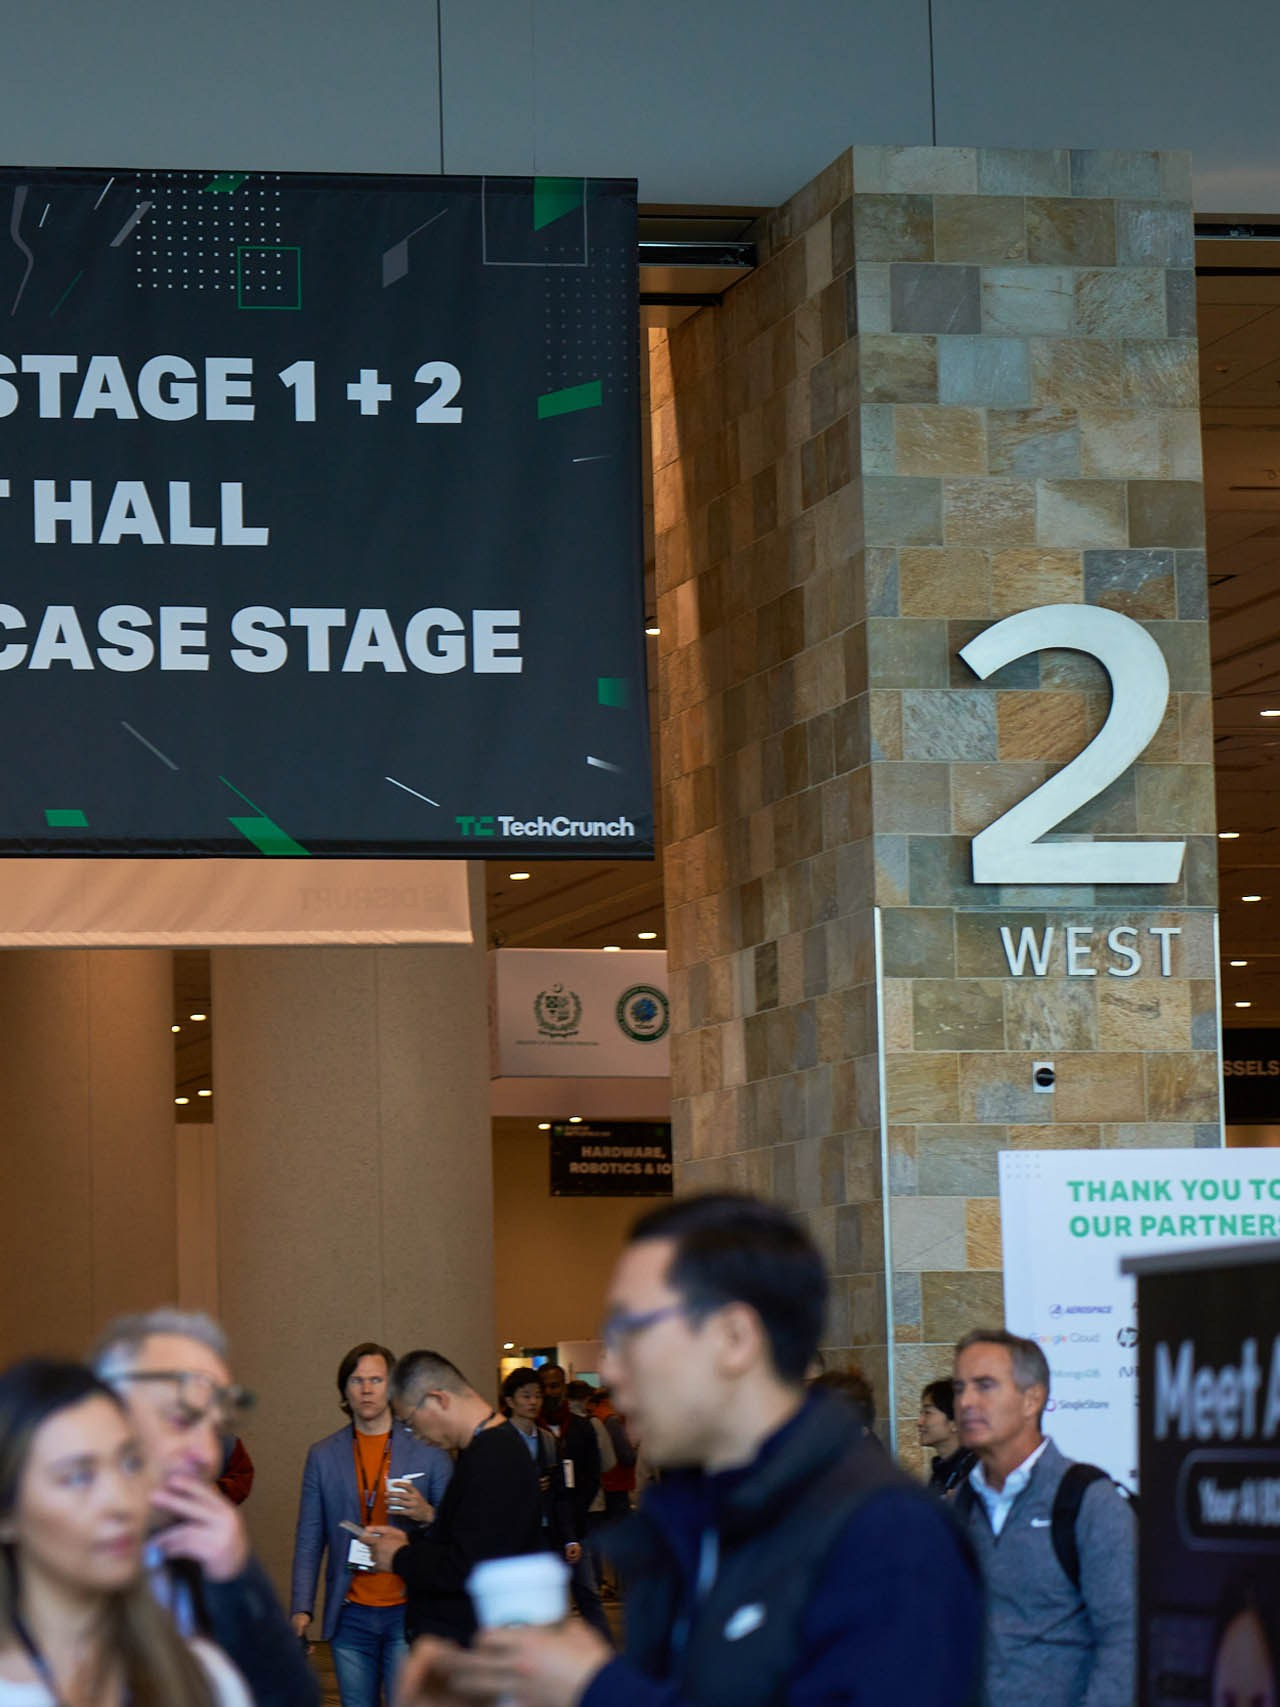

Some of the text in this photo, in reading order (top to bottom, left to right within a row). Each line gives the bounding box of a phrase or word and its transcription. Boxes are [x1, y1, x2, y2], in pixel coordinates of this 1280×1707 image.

[278, 360, 316, 422] 1
[346, 369, 392, 416] +
[414, 361, 463, 424] 2
[33, 479, 270, 546] HALL
[230, 605, 523, 675] STAGE
[958, 603, 1187, 884] 2
[455, 815, 635, 837] TC TechCrunch
[999, 926, 1182, 977] WEST
[569, 1162, 642, 1174] ROBOTICS
[1067, 1180, 1172, 1201] THANK
[1180, 1179, 1241, 1201] YOU
[1070, 1214, 1280, 1237] OUR PARTNER
[1154, 1339, 1262, 1439] Meet
